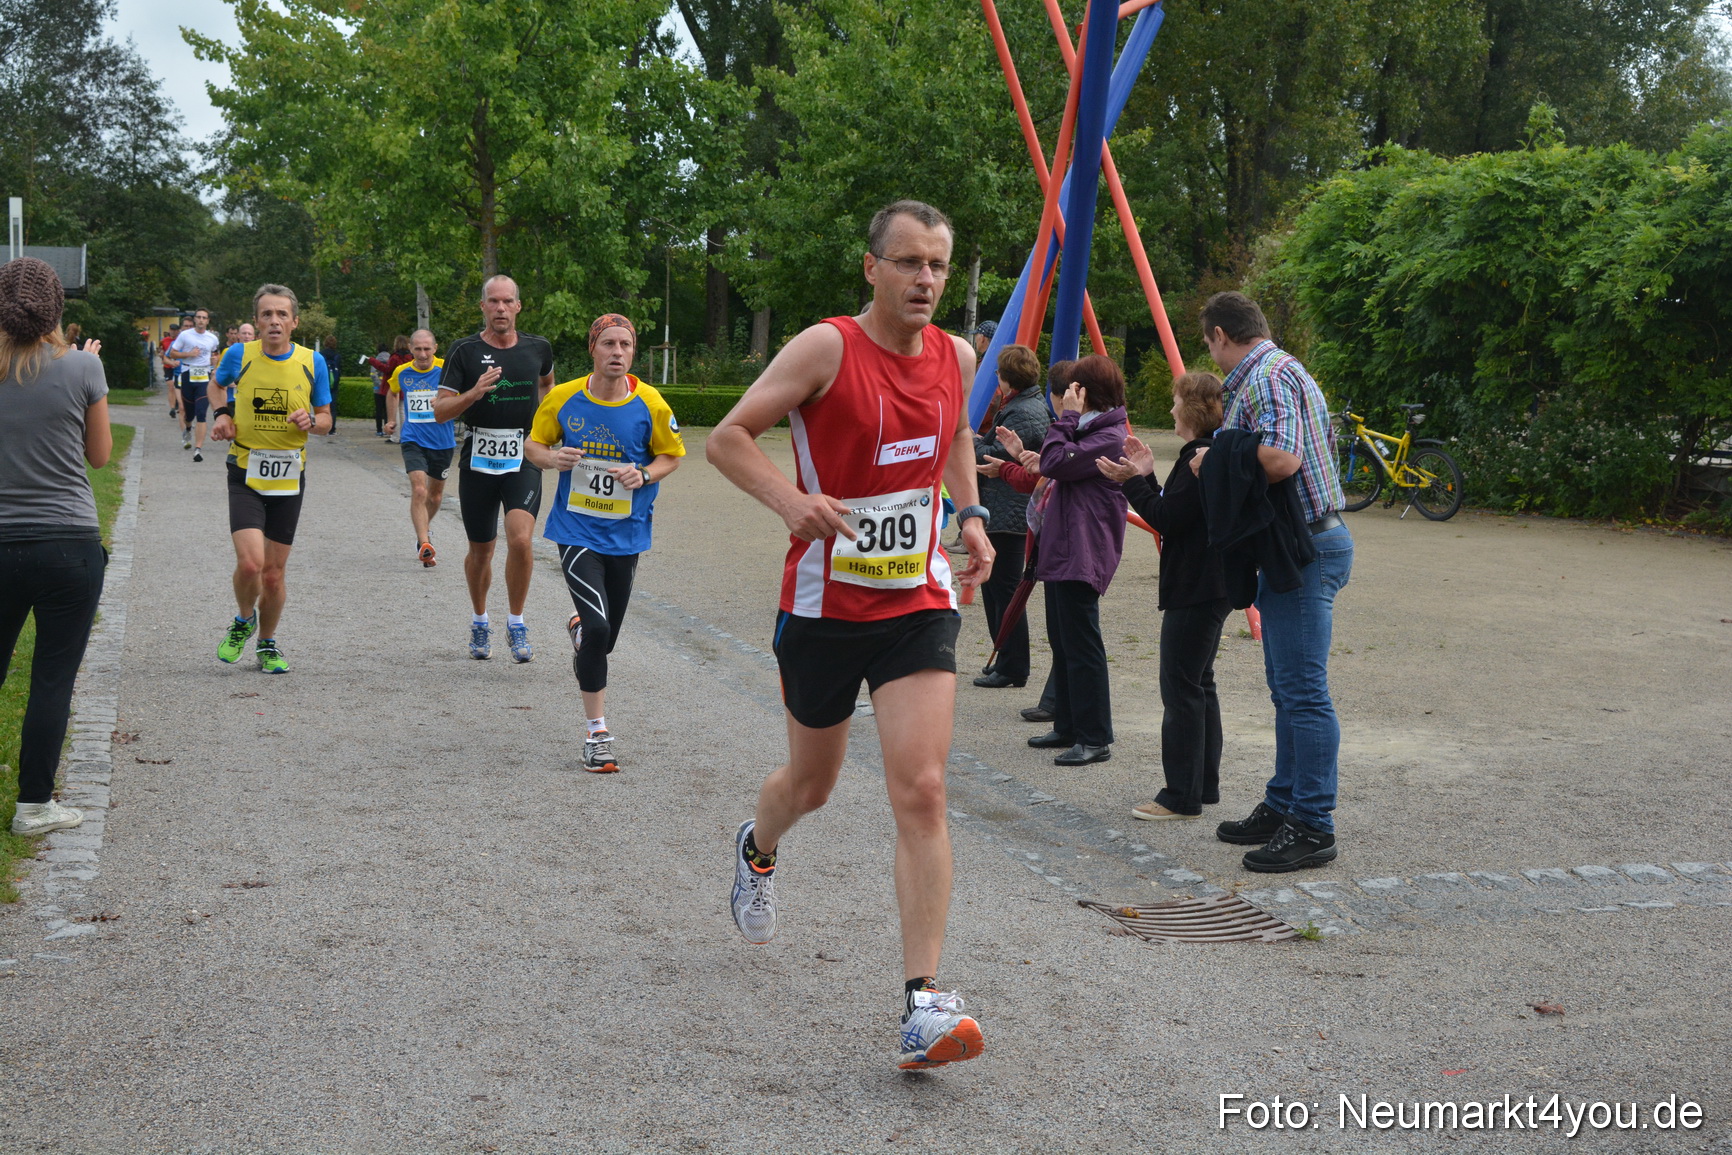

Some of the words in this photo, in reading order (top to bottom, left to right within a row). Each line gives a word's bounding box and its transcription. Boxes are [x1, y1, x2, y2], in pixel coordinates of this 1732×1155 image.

[409, 398, 432, 411] 221
[254, 414, 288, 423] HIRSCH
[477, 438, 518, 457] 2343
[894, 445, 921, 457] DEHN
[259, 460, 292, 478] 607
[487, 460, 505, 469] Peter
[577, 462, 592, 471] ARTL
[589, 474, 614, 496] 49
[585, 498, 614, 511] Roland
[873, 500, 917, 512] Neumarkt
[857, 514, 917, 553] 309
[849, 562, 883, 575] Hans
[888, 561, 920, 576] Peter
